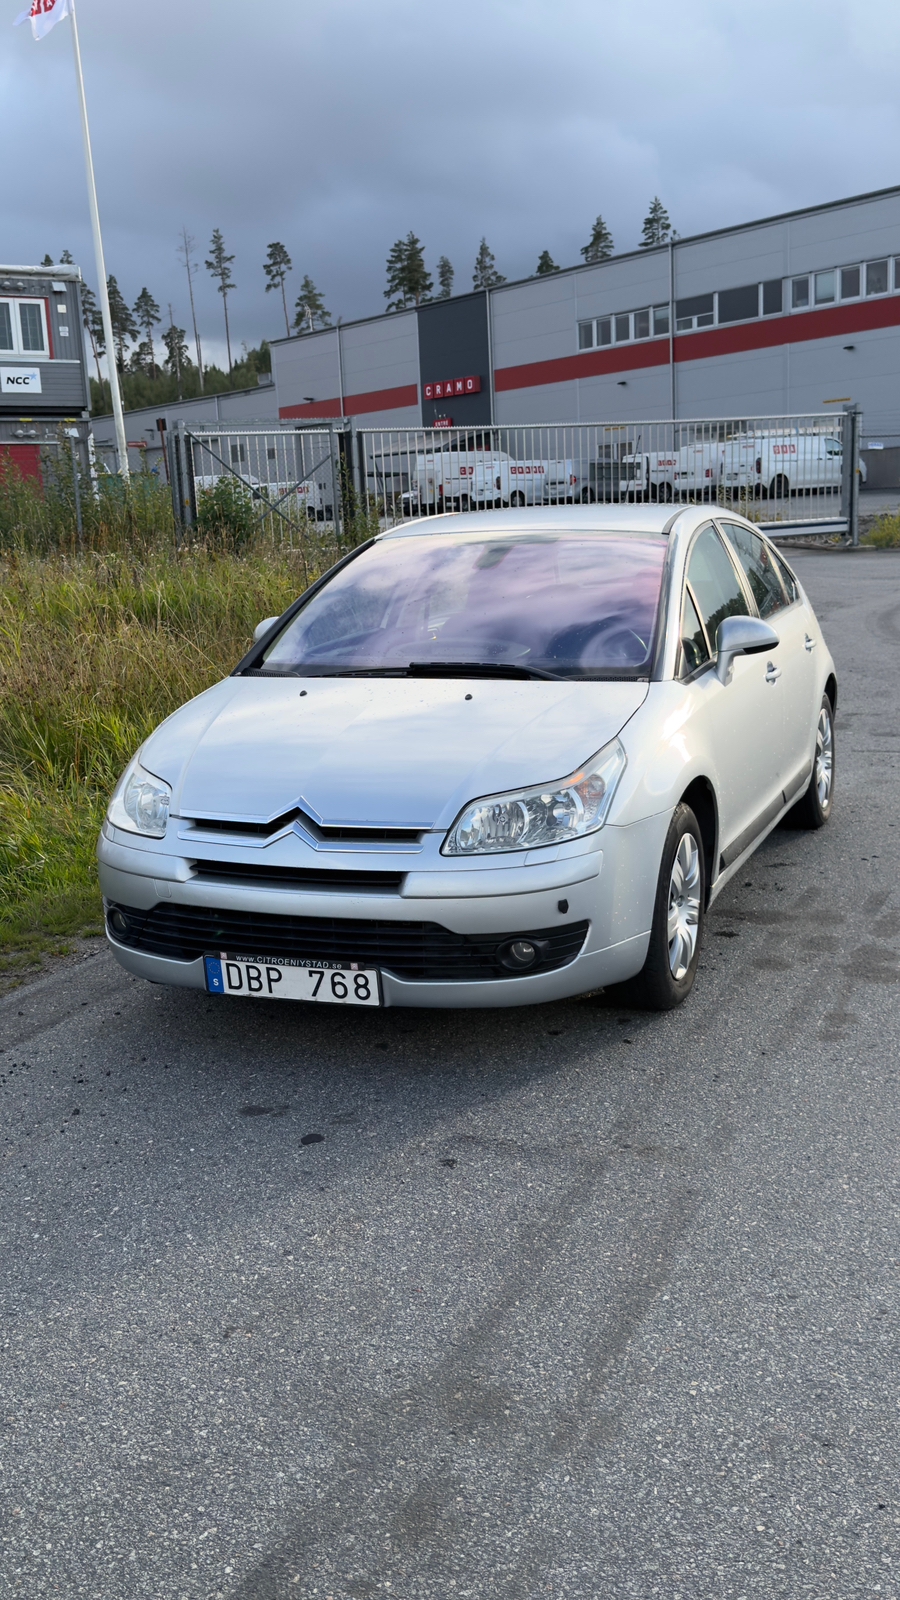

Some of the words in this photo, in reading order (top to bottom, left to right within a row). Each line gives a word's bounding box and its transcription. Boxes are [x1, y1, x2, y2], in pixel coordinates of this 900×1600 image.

[6, 376, 30, 384] NCC
[425, 379, 473, 396] CRAMO
[235, 955, 342, 970] www.CITROENIYSTAD.se
[226, 963, 282, 994] DBP
[308, 970, 371, 1001] 768
